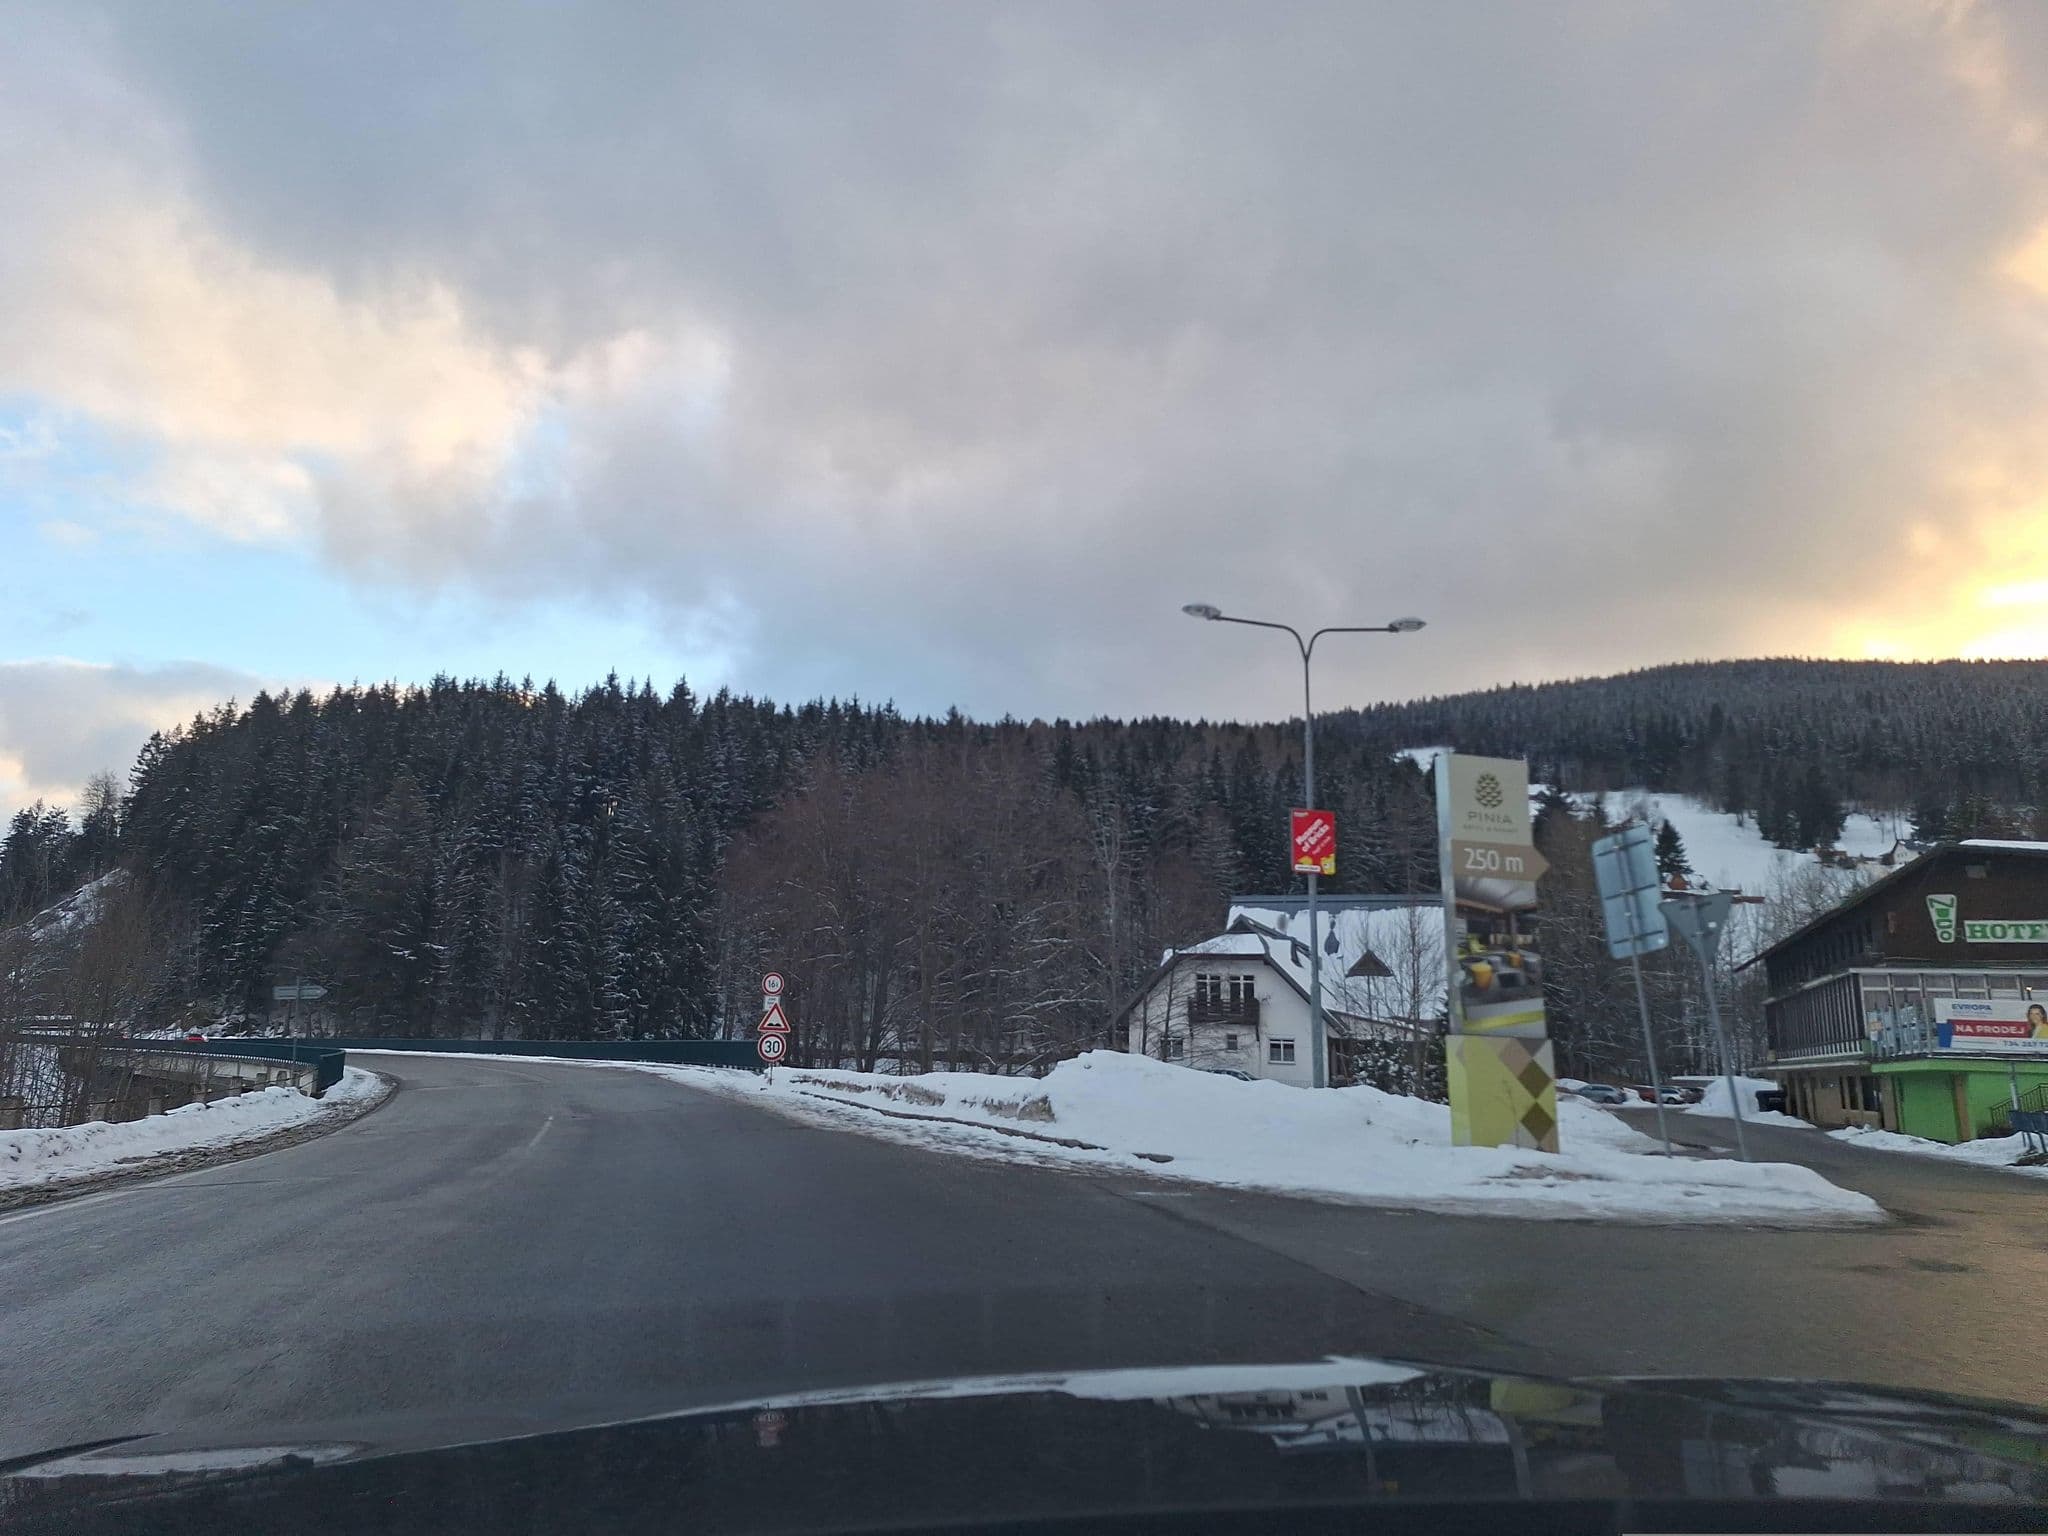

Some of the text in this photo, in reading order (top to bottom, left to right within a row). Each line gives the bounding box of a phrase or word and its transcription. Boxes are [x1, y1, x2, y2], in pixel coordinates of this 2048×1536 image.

[1463, 848, 1524, 872] 250 m
[1966, 924, 2048, 940] HOTE
[1955, 1024, 2025, 1034] NA PRODEJ
[764, 1040, 780, 1053] 30
